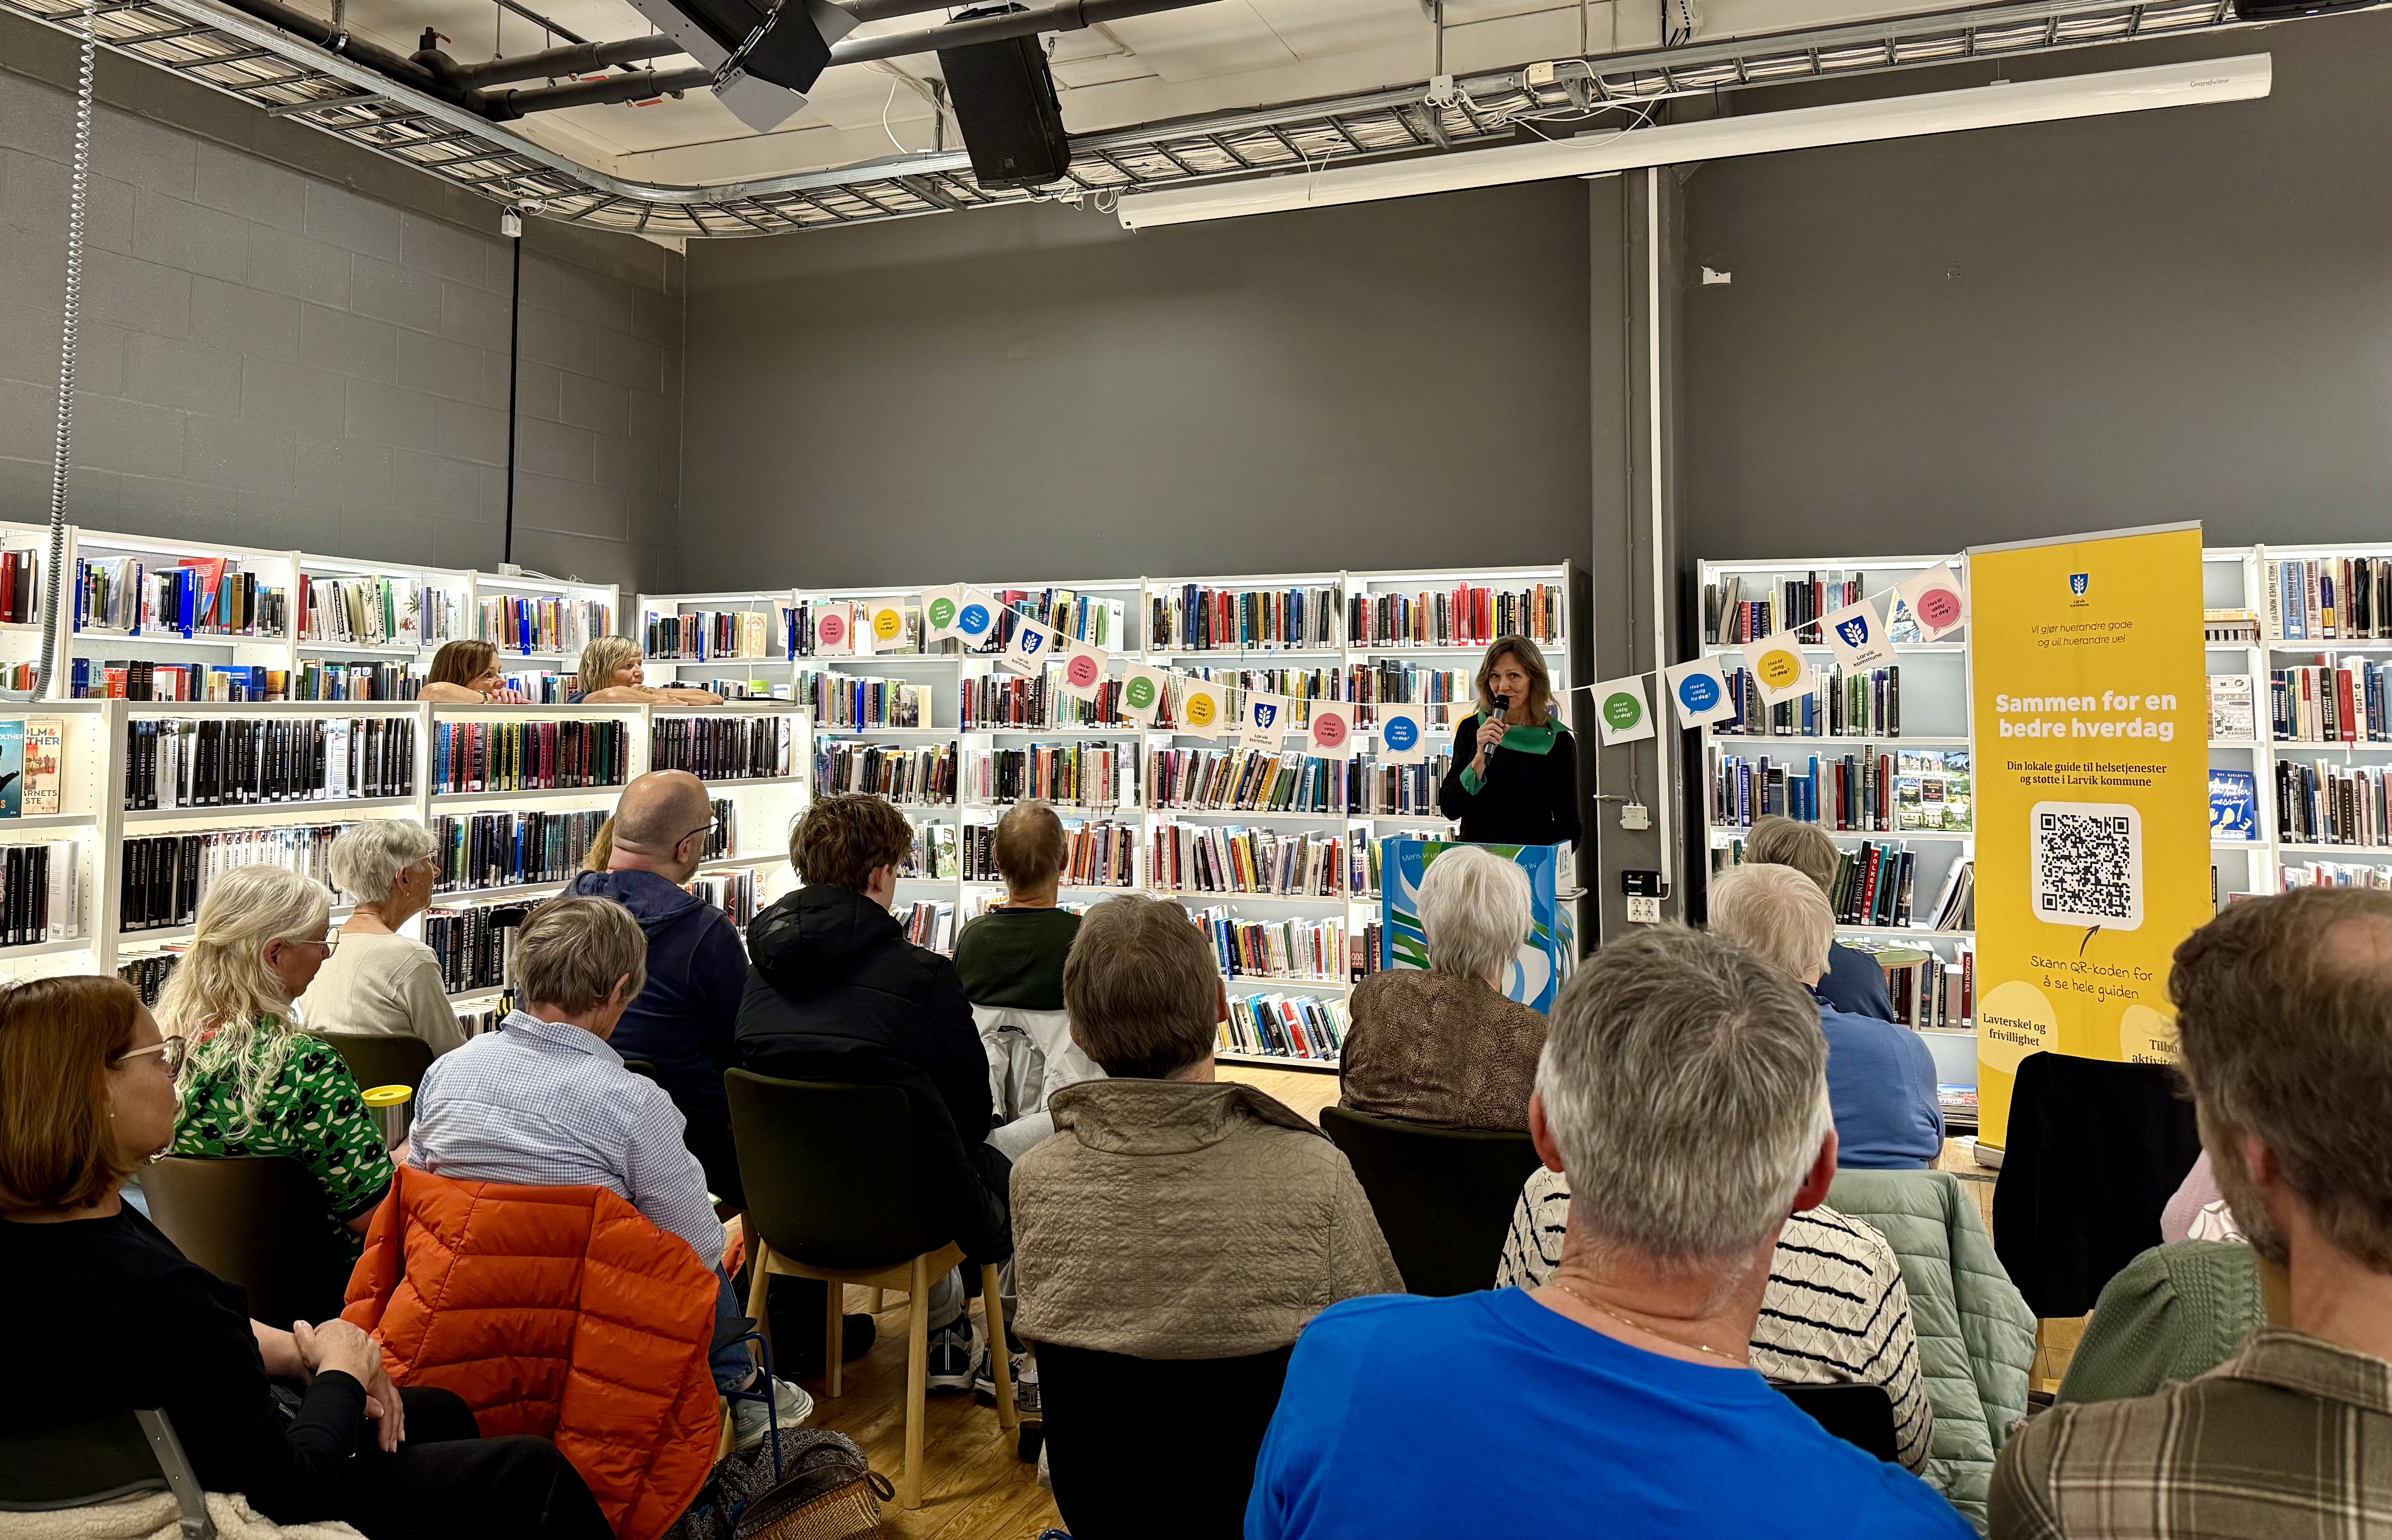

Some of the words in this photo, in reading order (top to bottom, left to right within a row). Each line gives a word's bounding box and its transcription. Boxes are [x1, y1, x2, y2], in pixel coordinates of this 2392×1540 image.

[2190, 78, 2229, 87] Grandview
[1932, 604, 1945, 612] viktig
[1939, 606, 1951, 616] deg?
[2031, 626, 2039, 634] Vi
[2041, 625, 2058, 635] gjør
[2108, 620, 2133, 631] gode
[2038, 639, 2050, 648] og
[1017, 656, 1029, 665] Larvik
[1853, 653, 1882, 667] kommune
[1857, 650, 1874, 660] Larvik
[1012, 659, 1031, 670] kommune
[2312, 679, 2320, 704] RETRO
[1996, 693, 2096, 712] Sammen
[2102, 691, 2140, 711] for
[2146, 693, 2177, 710] en
[2000, 720, 2067, 737] bedre
[2072, 717, 2174, 742] hverdag
[2007, 761, 2023, 770] Din
[2024, 761, 2053, 771] lokale
[2055, 762, 2081, 774] guide
[2083, 763, 2093, 772] til
[2095, 763, 2167, 775] helsetjenester
[2020, 777, 2031, 786] og
[2033, 775, 2060, 784] støtte
[2062, 775, 2065, 784] i
[2067, 775, 2098, 785] Larvik
[2100, 776, 2152, 786] kommune
[1402, 853, 1421, 862] Mens
[1868, 852, 1878, 896] FOLKETS
[1855, 861, 1867, 906] STORTINGET
[1351, 952, 1364, 966] 999
[2031, 956, 2067, 971] Skann
[2070, 961, 2129, 979] QR-koden
[2133, 968, 2153, 982] for
[2043, 975, 2051, 987] å
[2055, 979, 2068, 989] se
[2073, 979, 2094, 993] hele
[2098, 986, 2139, 1002] guiden
[1983, 1013, 2032, 1030] Lavterskel
[2034, 1023, 2046, 1034] og
[1989, 1029, 2039, 1046] frivillighet
[2149, 1040, 2180, 1054] Tilbu
